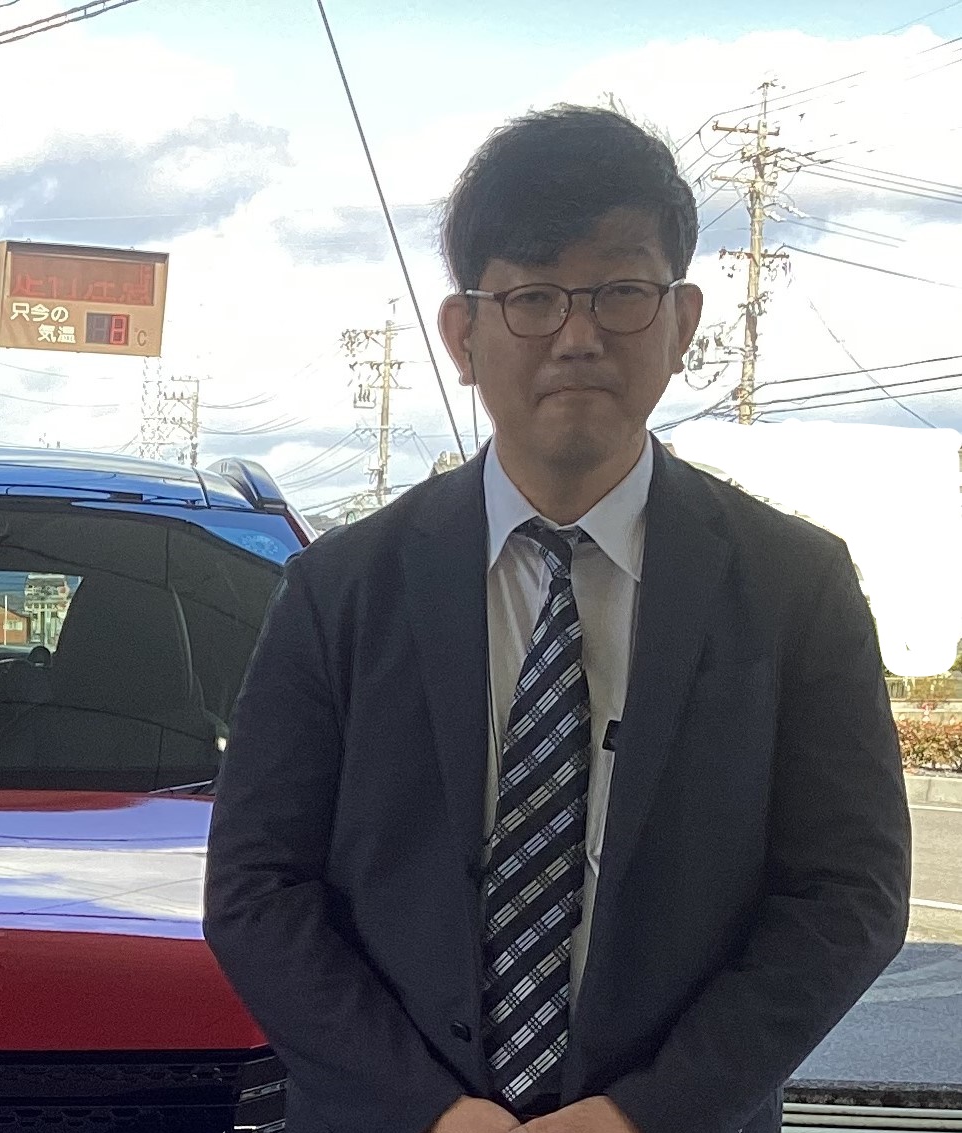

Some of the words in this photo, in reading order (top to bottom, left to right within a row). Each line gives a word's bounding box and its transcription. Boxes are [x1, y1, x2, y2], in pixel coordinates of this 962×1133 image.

[10, 302, 69, 323] 只今の
[38, 324, 77, 344] 気温
